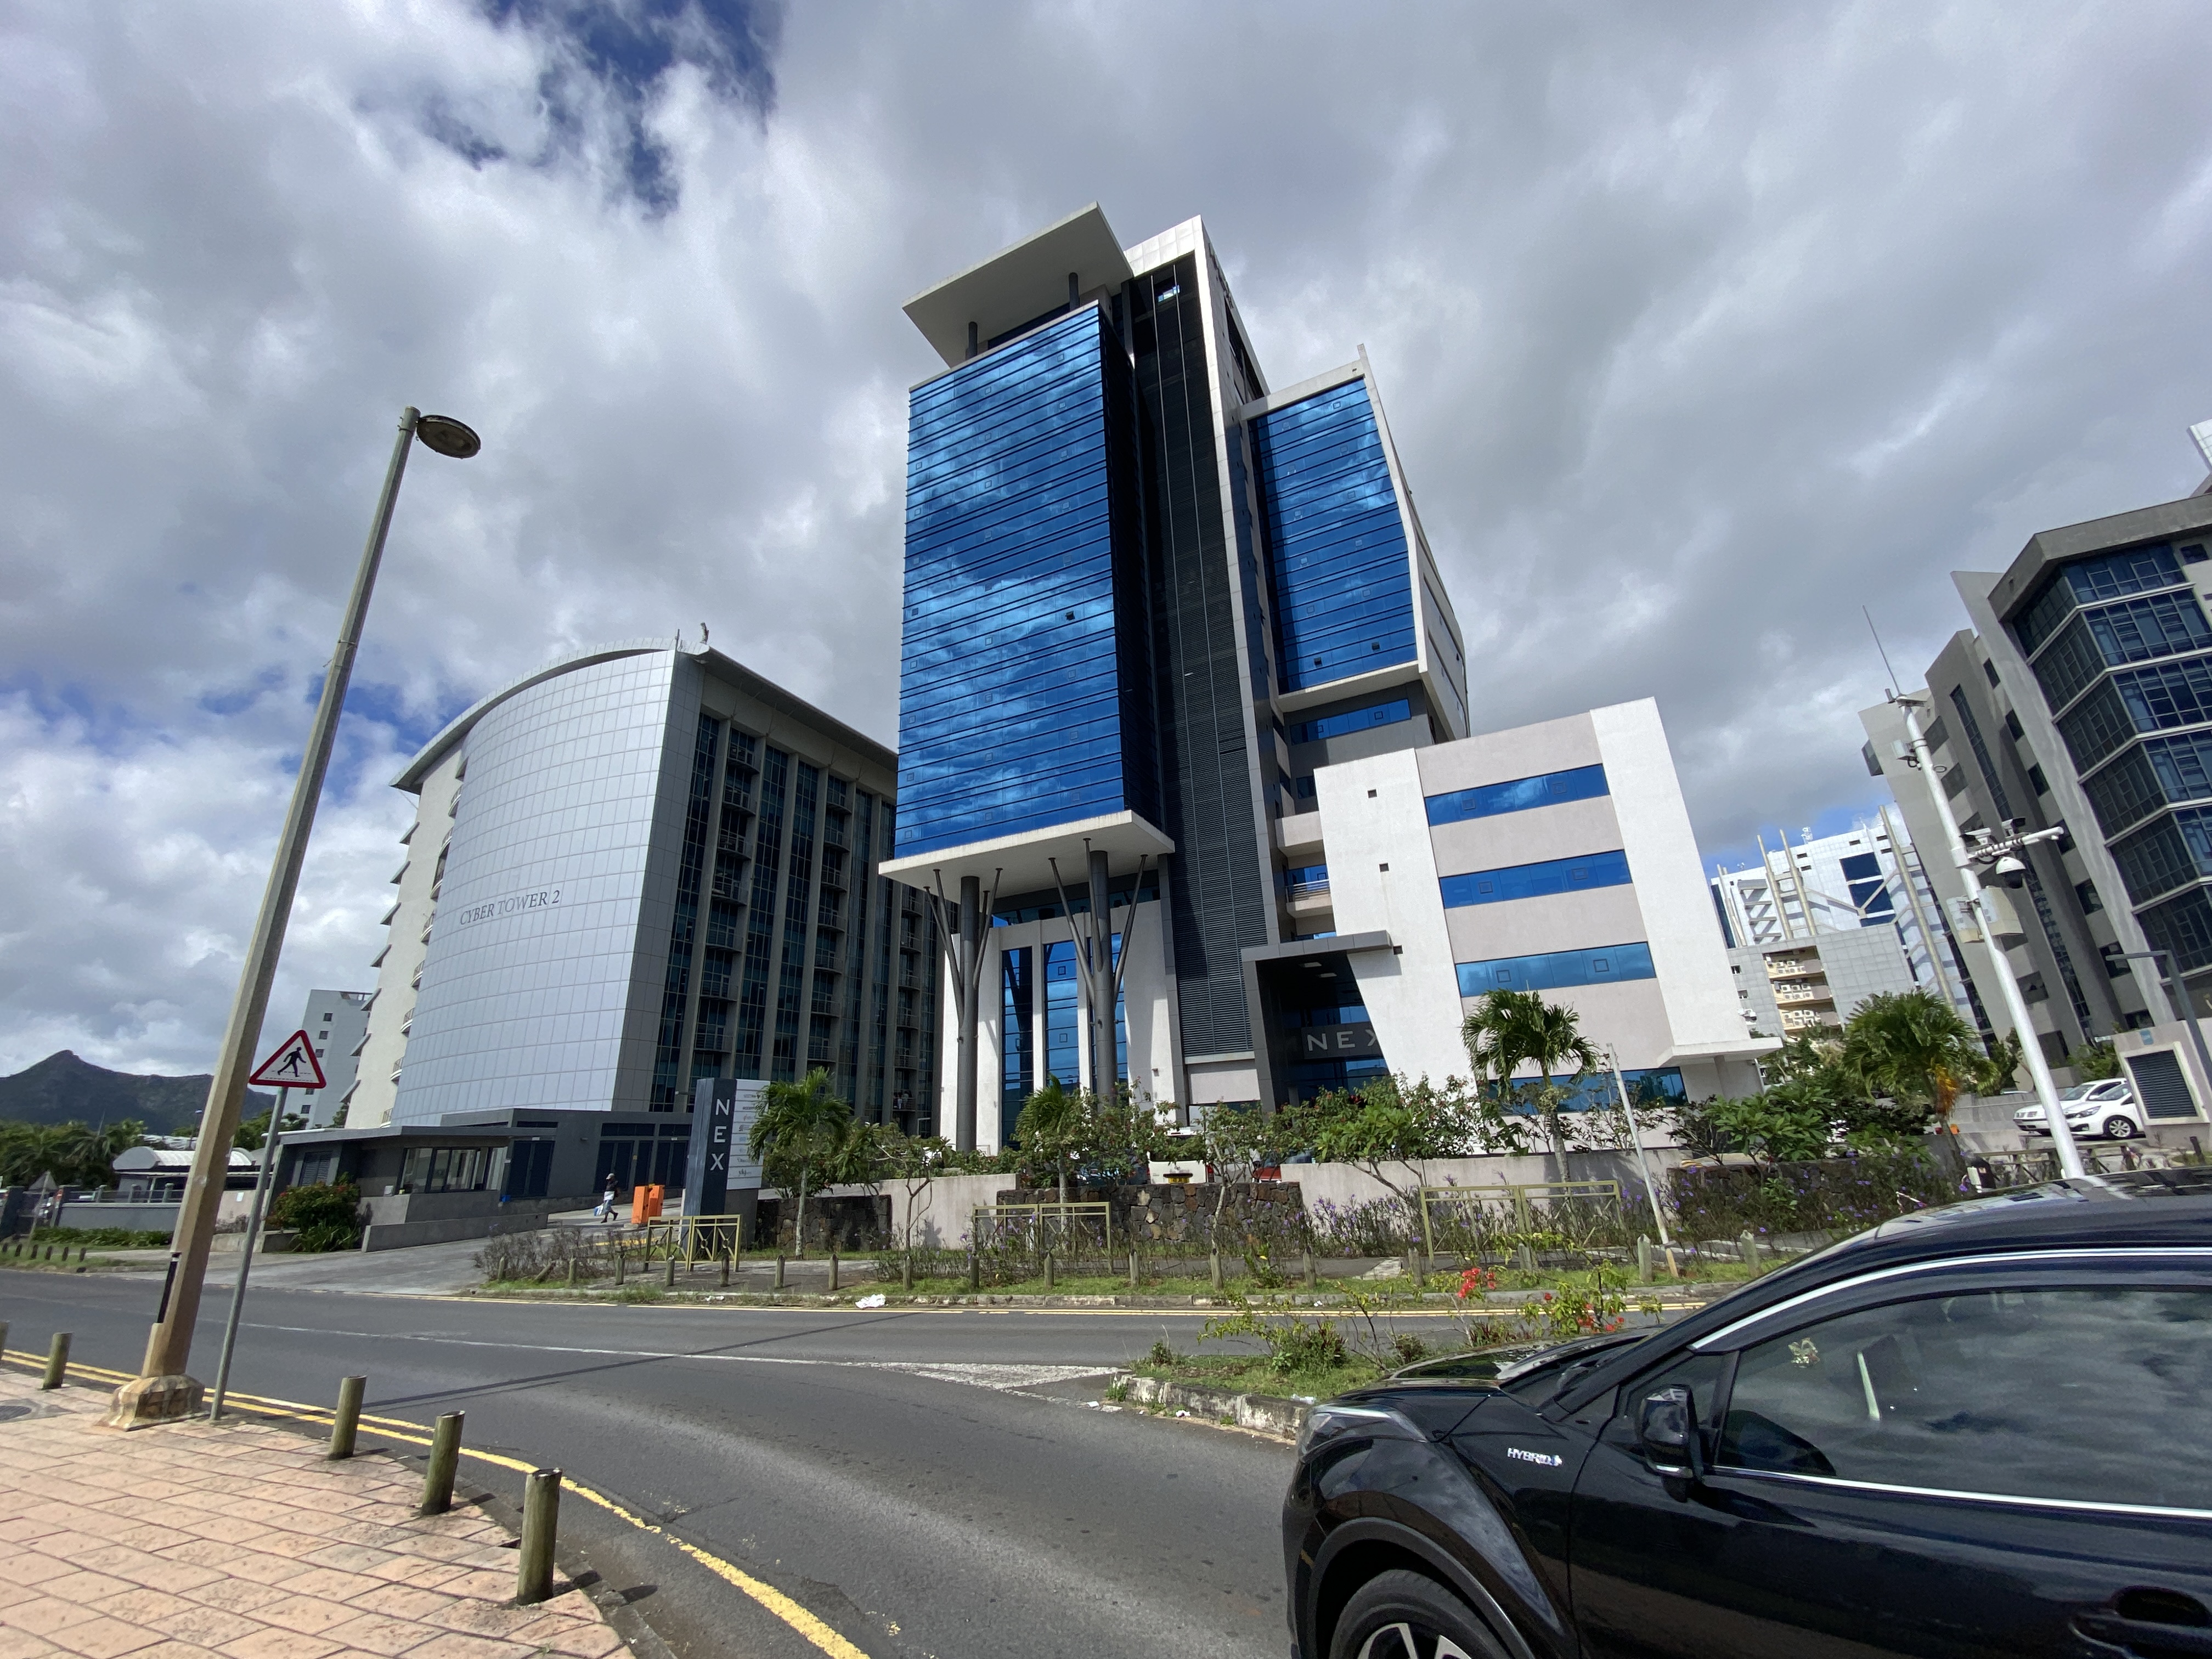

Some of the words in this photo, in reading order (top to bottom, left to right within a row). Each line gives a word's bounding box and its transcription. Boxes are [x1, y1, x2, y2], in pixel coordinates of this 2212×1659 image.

[460, 903, 494, 925] CYBER
[498, 891, 548, 915] TOWER
[551, 889, 560, 904] 2
[1307, 1029, 1378, 1051] NEX
[710, 1098, 730, 1171] NEX
[1507, 1447, 1551, 1465] HYBRID
